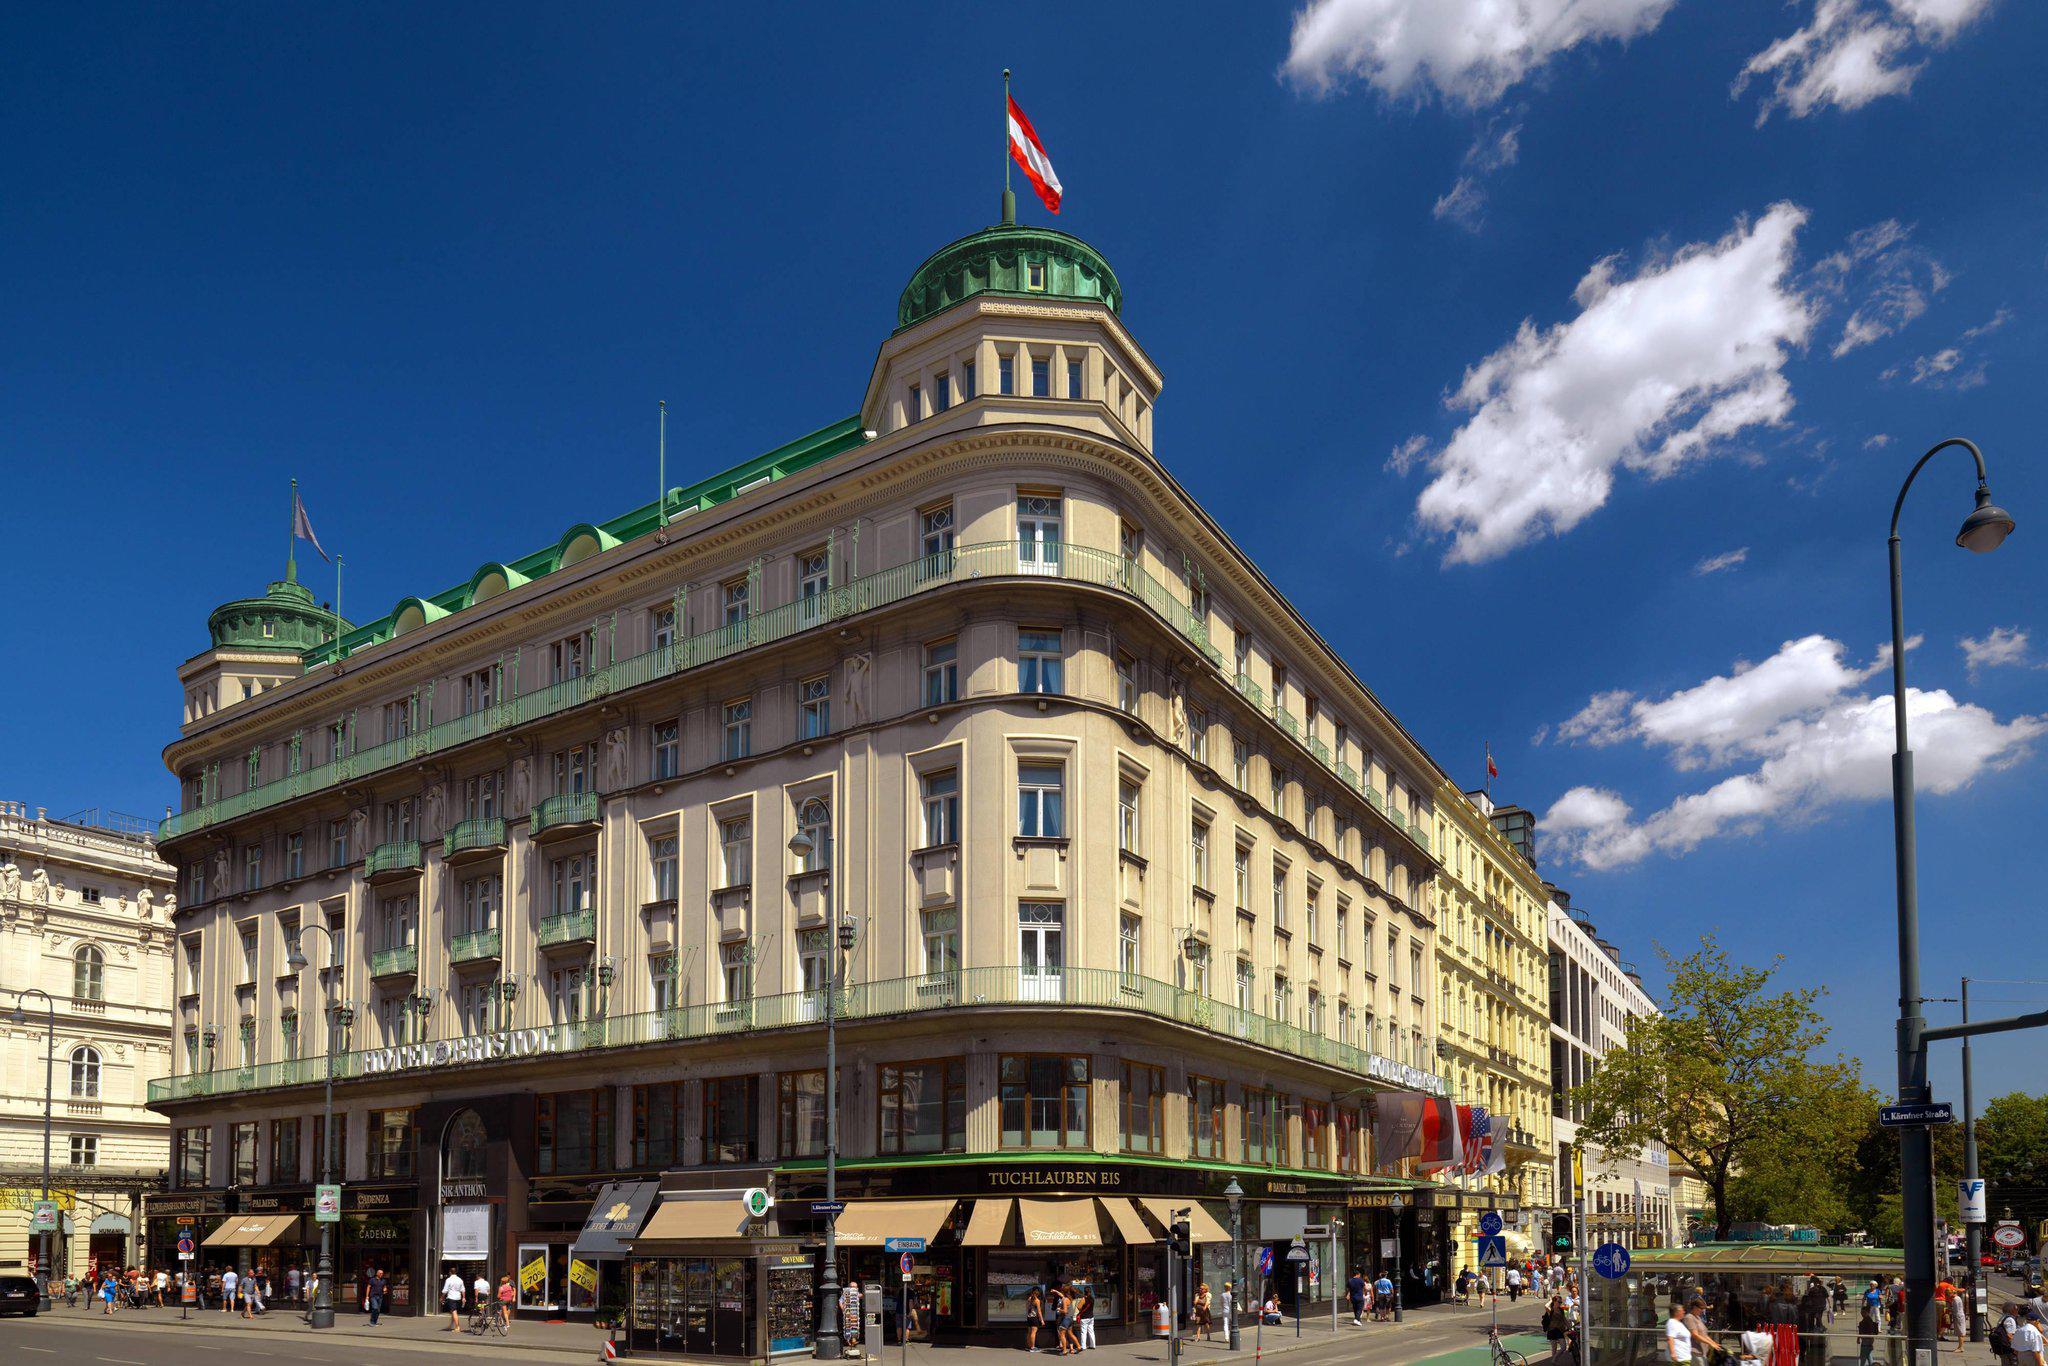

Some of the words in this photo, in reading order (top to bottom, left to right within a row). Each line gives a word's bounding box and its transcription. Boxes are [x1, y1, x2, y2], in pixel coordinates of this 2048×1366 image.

[364, 1043, 434, 1073] HOTEL
[452, 1028, 556, 1062] BRISTOL
[1891, 1111, 1923, 1121] Kärntner
[1924, 1109, 1949, 1119] Straße
[988, 1171, 1096, 1185] TUCHLAUBEN
[1100, 1171, 1121, 1185] EIS
[441, 1184, 453, 1197] SIR
[453, 1183, 487, 1197] ANTHONY
[1273, 1182, 1286, 1192] BANK
[252, 1198, 279, 1208] PALMERS
[357, 1193, 390, 1205] CADENZA
[1352, 1195, 1410, 1206] BRISTL
[359, 1229, 398, 1240] CADENZA
[1030, 1229, 1080, 1241] Tuchlauben
[1083, 1232, 1097, 1240] eis
[781, 1255, 805, 1264] SOUVENIRS
[524, 1270, 545, 1286] -70%
[571, 1272, 593, 1290] -70%
